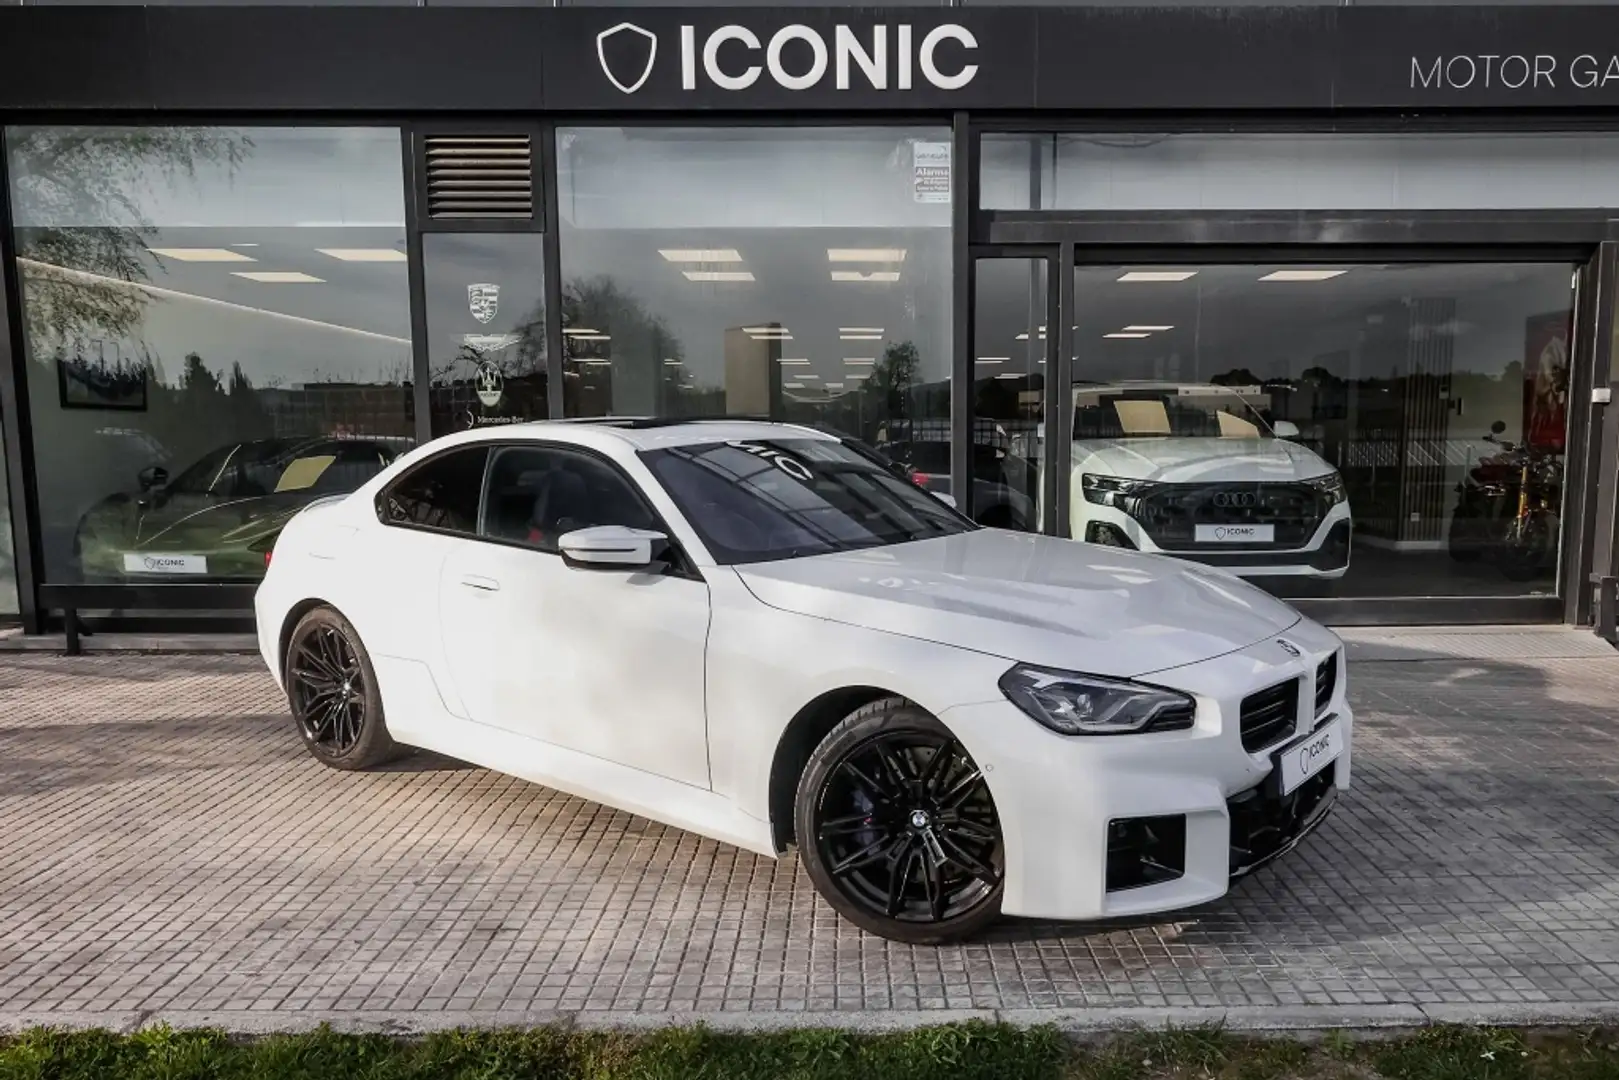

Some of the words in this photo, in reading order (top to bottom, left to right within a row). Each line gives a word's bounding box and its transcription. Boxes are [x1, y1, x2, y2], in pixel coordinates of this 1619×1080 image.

[681, 23, 979, 90] ICONIC
[1410, 54, 1557, 89] MOTOR
[1227, 527, 1255, 536] ICONIC
[156, 559, 185, 567] ICONIC
